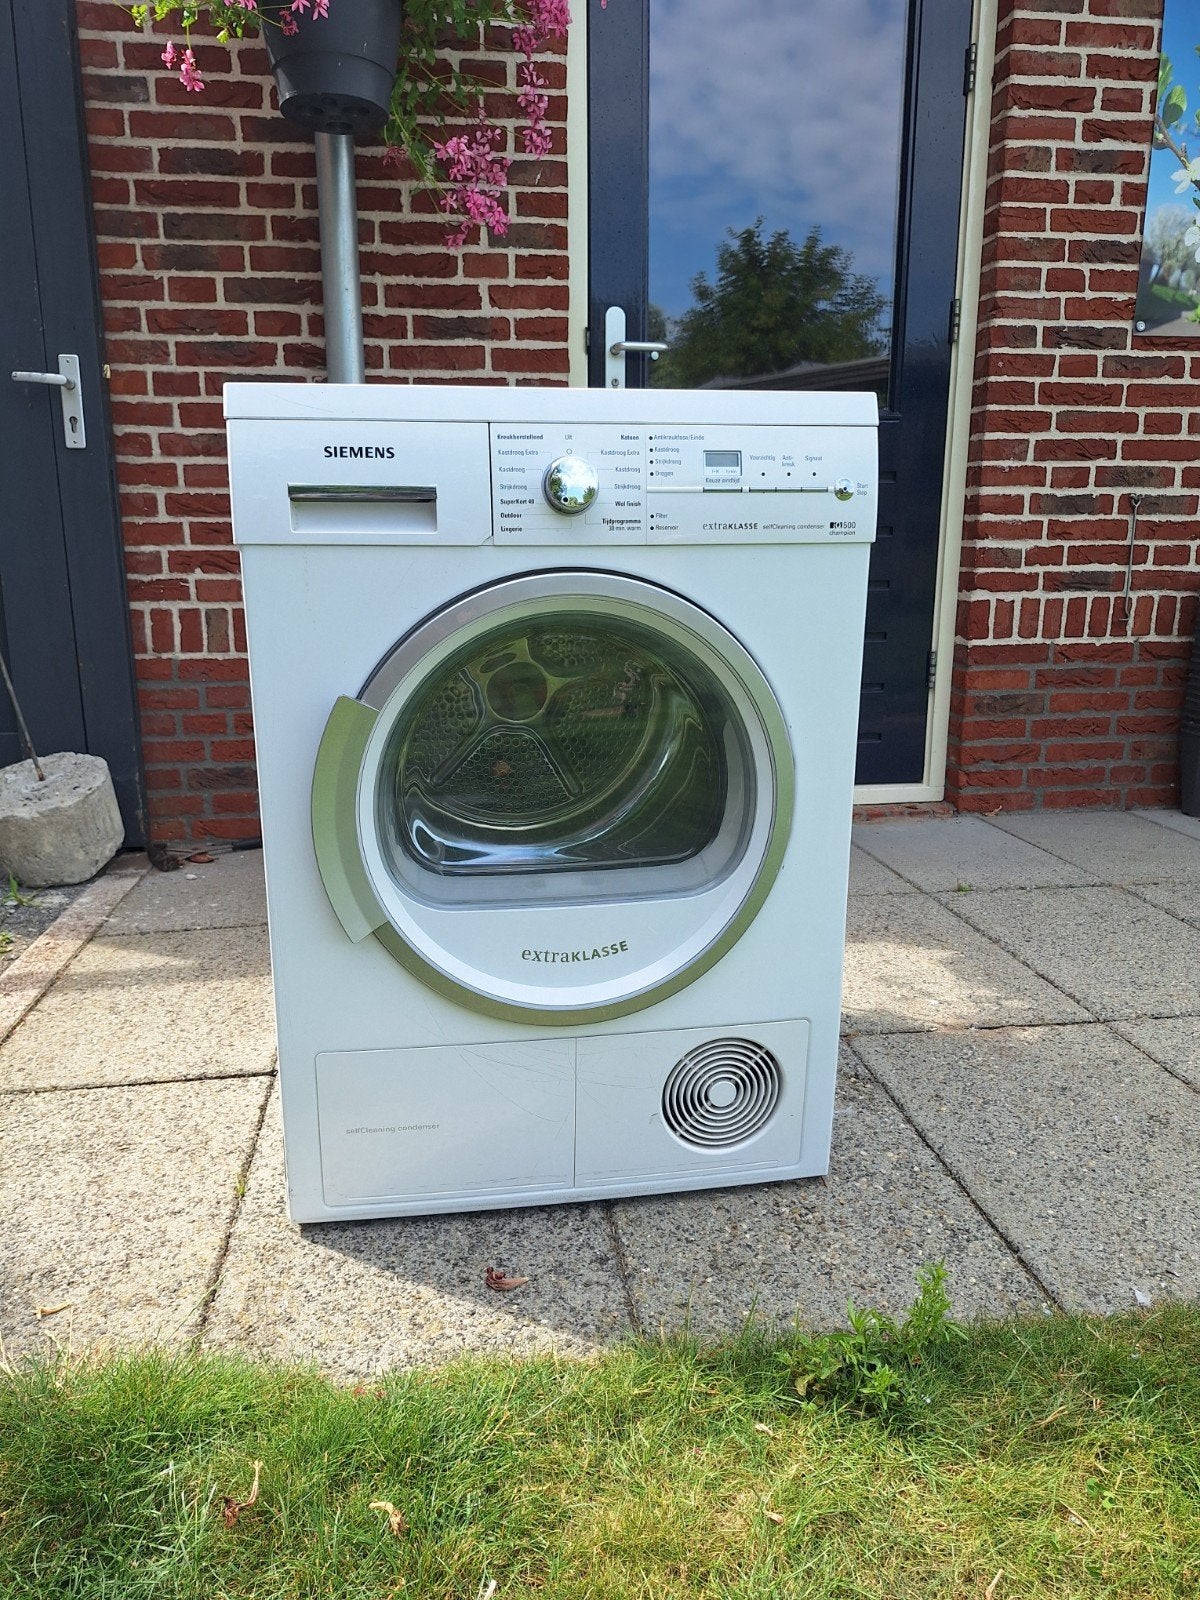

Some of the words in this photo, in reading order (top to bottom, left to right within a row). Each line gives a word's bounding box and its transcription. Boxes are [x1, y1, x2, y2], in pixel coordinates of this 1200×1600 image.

[323, 445, 395, 459] SIEMENS
[498, 449, 525, 457] Kastdroog
[600, 449, 628, 457] Kastdroog
[499, 466, 526, 474] Kastdroog
[615, 466, 641, 474] Kastdroog
[499, 483, 528, 492] Strijkdroog
[614, 483, 641, 492] Strijkdroog
[856, 489, 868, 497] Stop
[602, 518, 641, 526] Tijdprogramma
[702, 522, 759, 531] extraKLASSE
[762, 522, 796, 531] selfCleaning
[521, 940, 629, 963] extraKLASSE
[345, 1126, 396, 1135] selfCleaning
[397, 1123, 440, 1132] condenser
